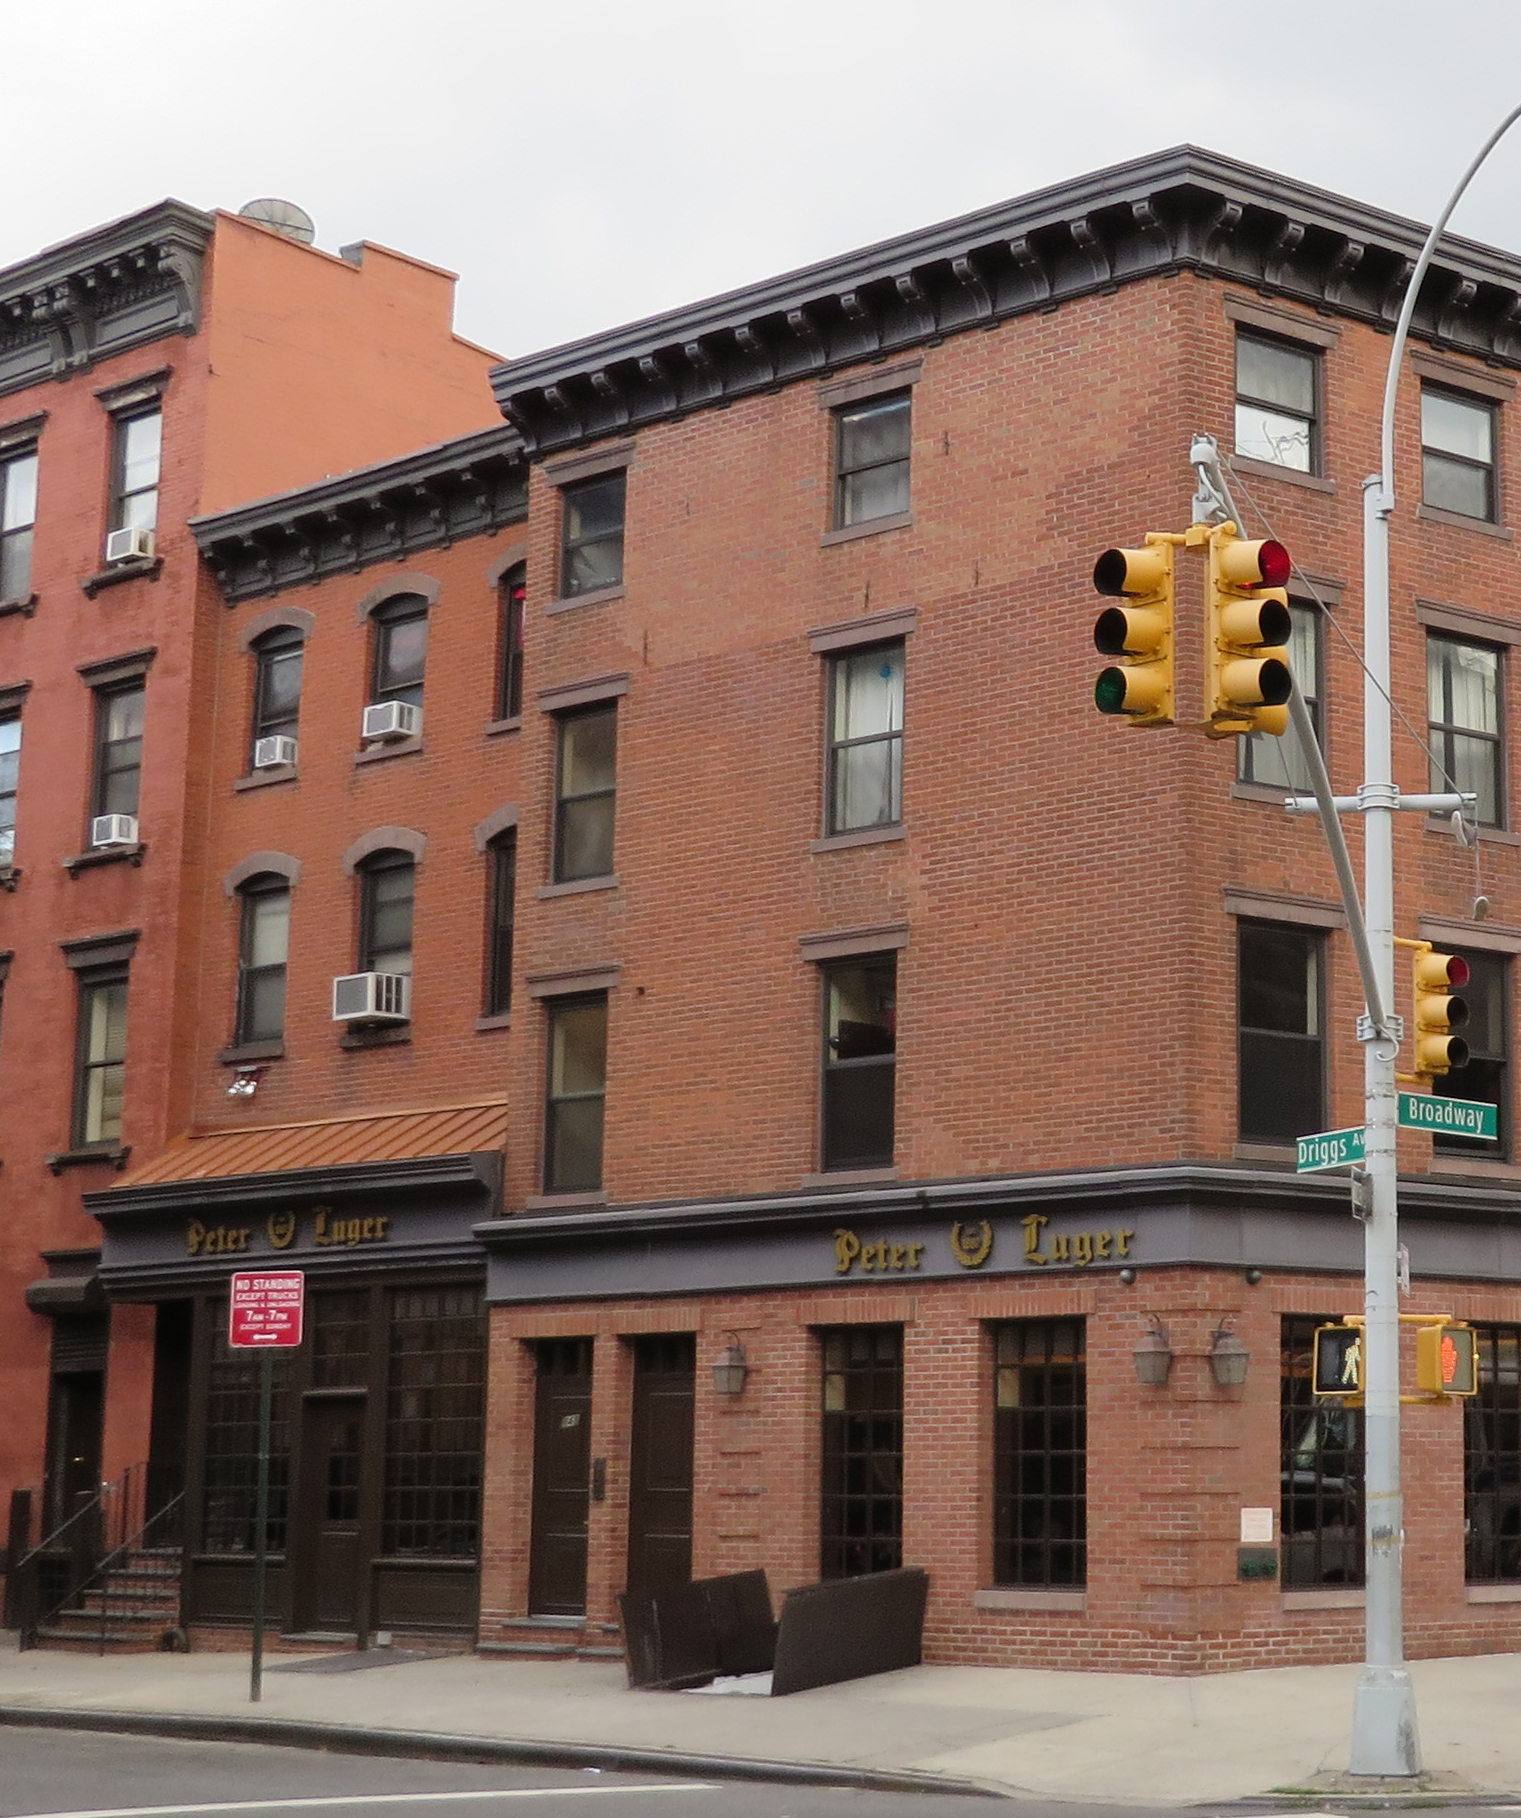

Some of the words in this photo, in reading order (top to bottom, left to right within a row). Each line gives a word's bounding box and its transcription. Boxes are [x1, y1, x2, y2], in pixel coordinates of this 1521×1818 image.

[1409, 1097, 1484, 1134] Broadway
[1299, 1137, 1347, 1166] Driggs
[188, 1217, 249, 1255] Peter
[312, 1206, 388, 1247] Luger
[832, 1228, 924, 1272] Peter
[1020, 1213, 1135, 1266] Luger
[236, 1280, 251, 1290] NO
[252, 1278, 300, 1290] STANDING
